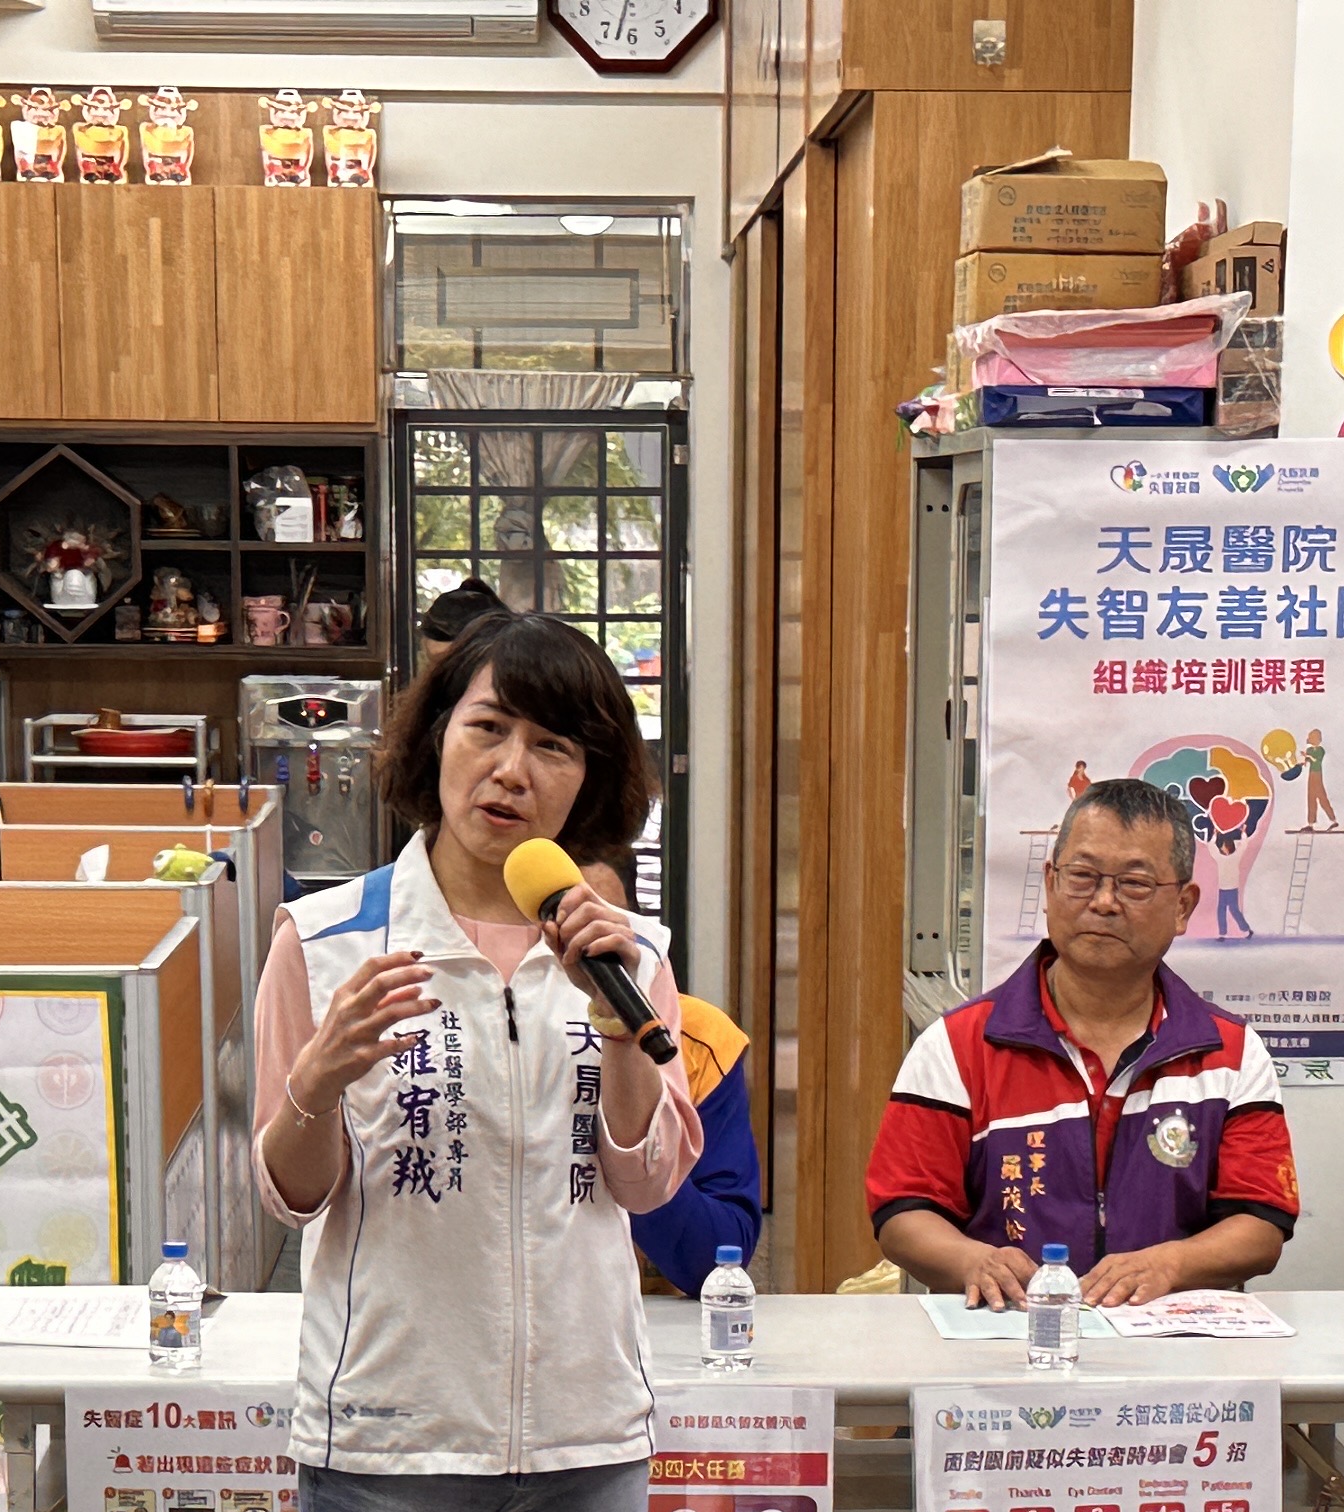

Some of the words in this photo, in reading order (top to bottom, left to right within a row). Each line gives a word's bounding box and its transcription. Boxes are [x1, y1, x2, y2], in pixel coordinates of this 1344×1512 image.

[627, 28, 638, 45] 6
[654, 20, 666, 38] 5
[1097, 525, 1337, 574] 天晟醫院
[1092, 658, 1326, 695] 組織培訓課程
